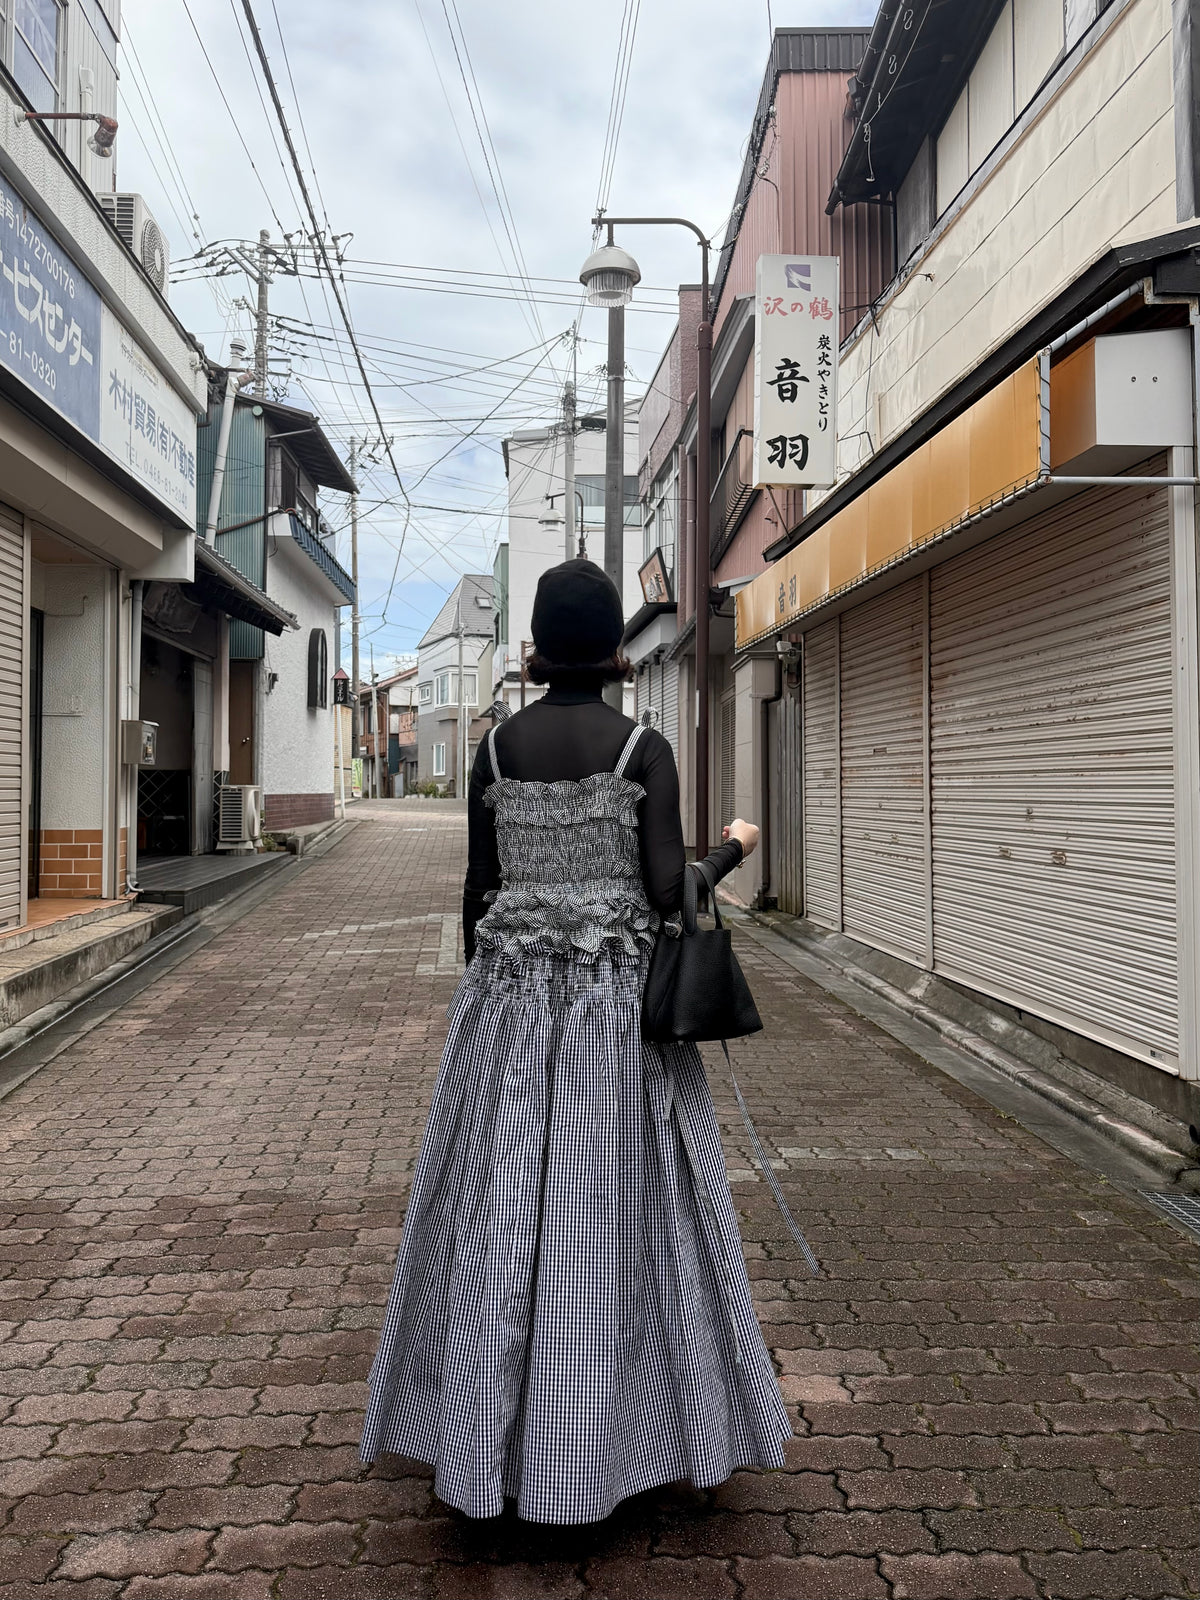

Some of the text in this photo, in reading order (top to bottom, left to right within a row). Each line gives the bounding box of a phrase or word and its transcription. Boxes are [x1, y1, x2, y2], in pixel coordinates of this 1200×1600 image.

[0, 240, 93, 366] ービスセンター
[764, 296, 834, 321] 沢の鶴
[765, 358, 810, 472] 音羽
[816, 334, 833, 432] 炭火やきとり
[777, 573, 797, 614] 音羽
